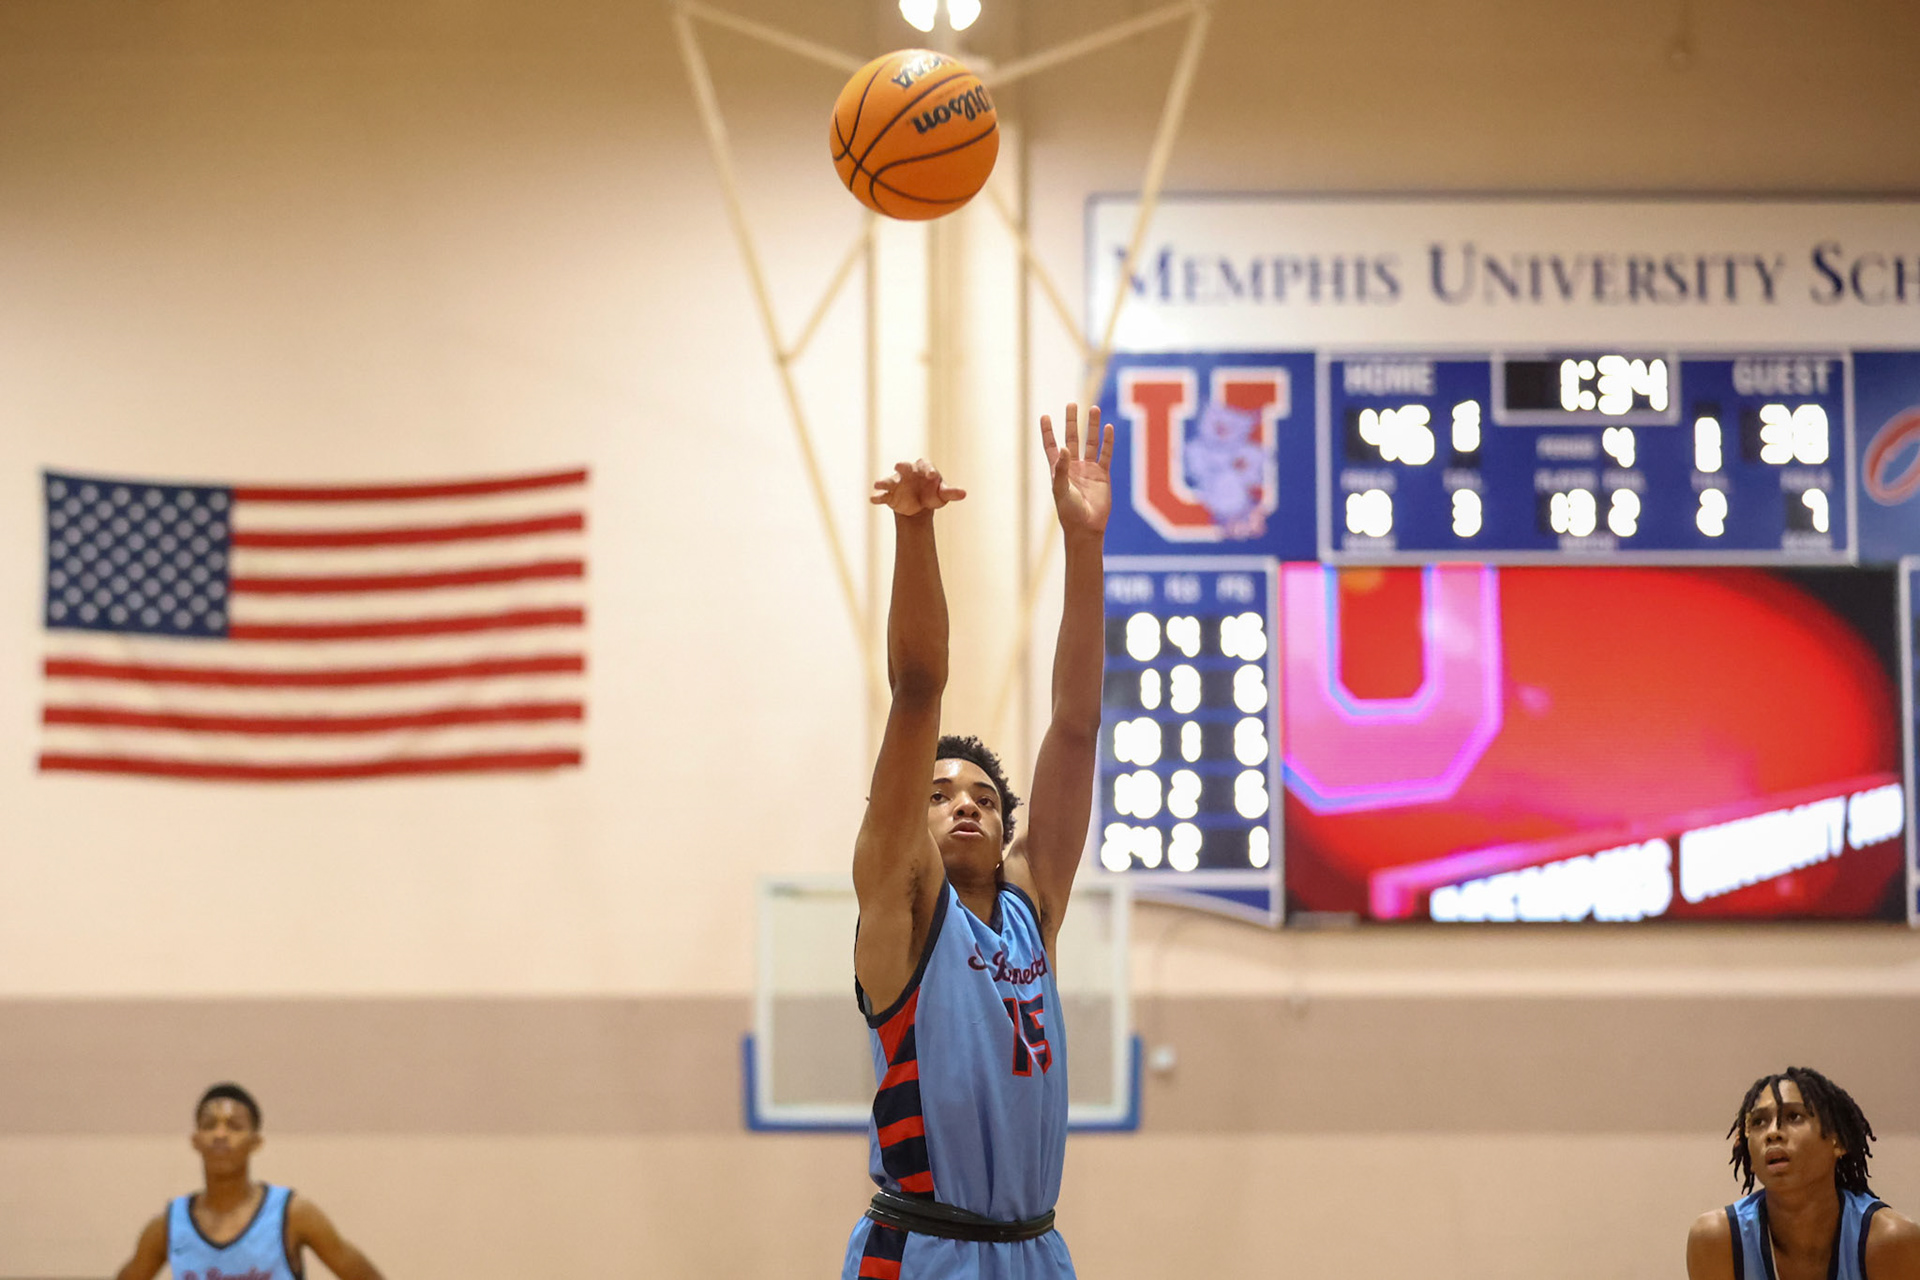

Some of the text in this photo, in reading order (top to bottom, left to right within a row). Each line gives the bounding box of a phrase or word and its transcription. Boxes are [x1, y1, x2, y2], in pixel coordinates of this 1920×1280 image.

[1114, 243, 1402, 304] MEMPHIS
[1427, 241, 1787, 304] UNIVERSITY
[1732, 360, 1830, 396] GUEST
[1002, 993, 1053, 1078] 15
